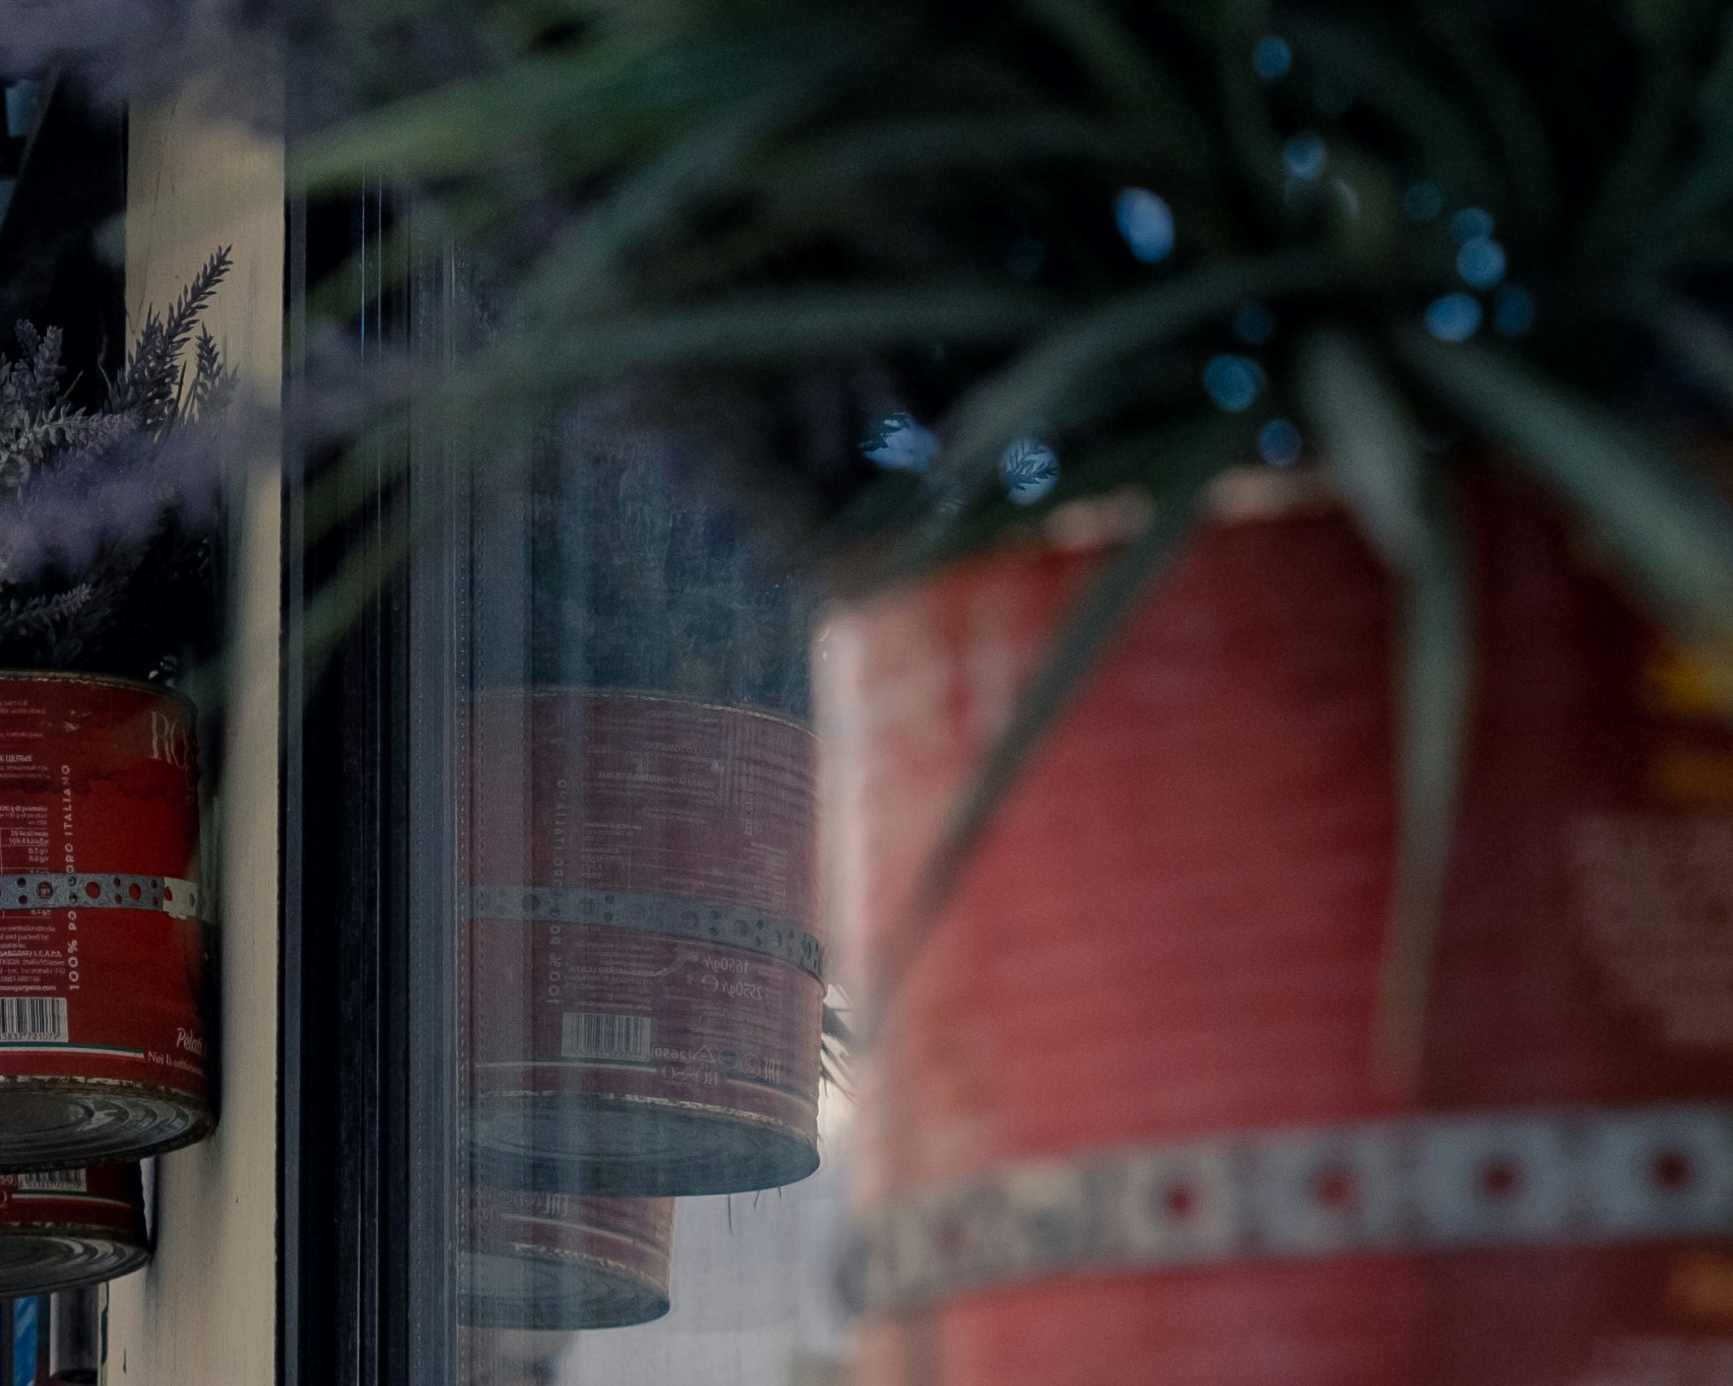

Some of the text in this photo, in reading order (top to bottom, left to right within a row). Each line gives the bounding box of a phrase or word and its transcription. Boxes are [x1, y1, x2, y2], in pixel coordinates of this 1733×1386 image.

[61, 764, 74, 836] ITALIANO
[65, 842, 78, 932] POORO
[67, 939, 80, 992] 100%
